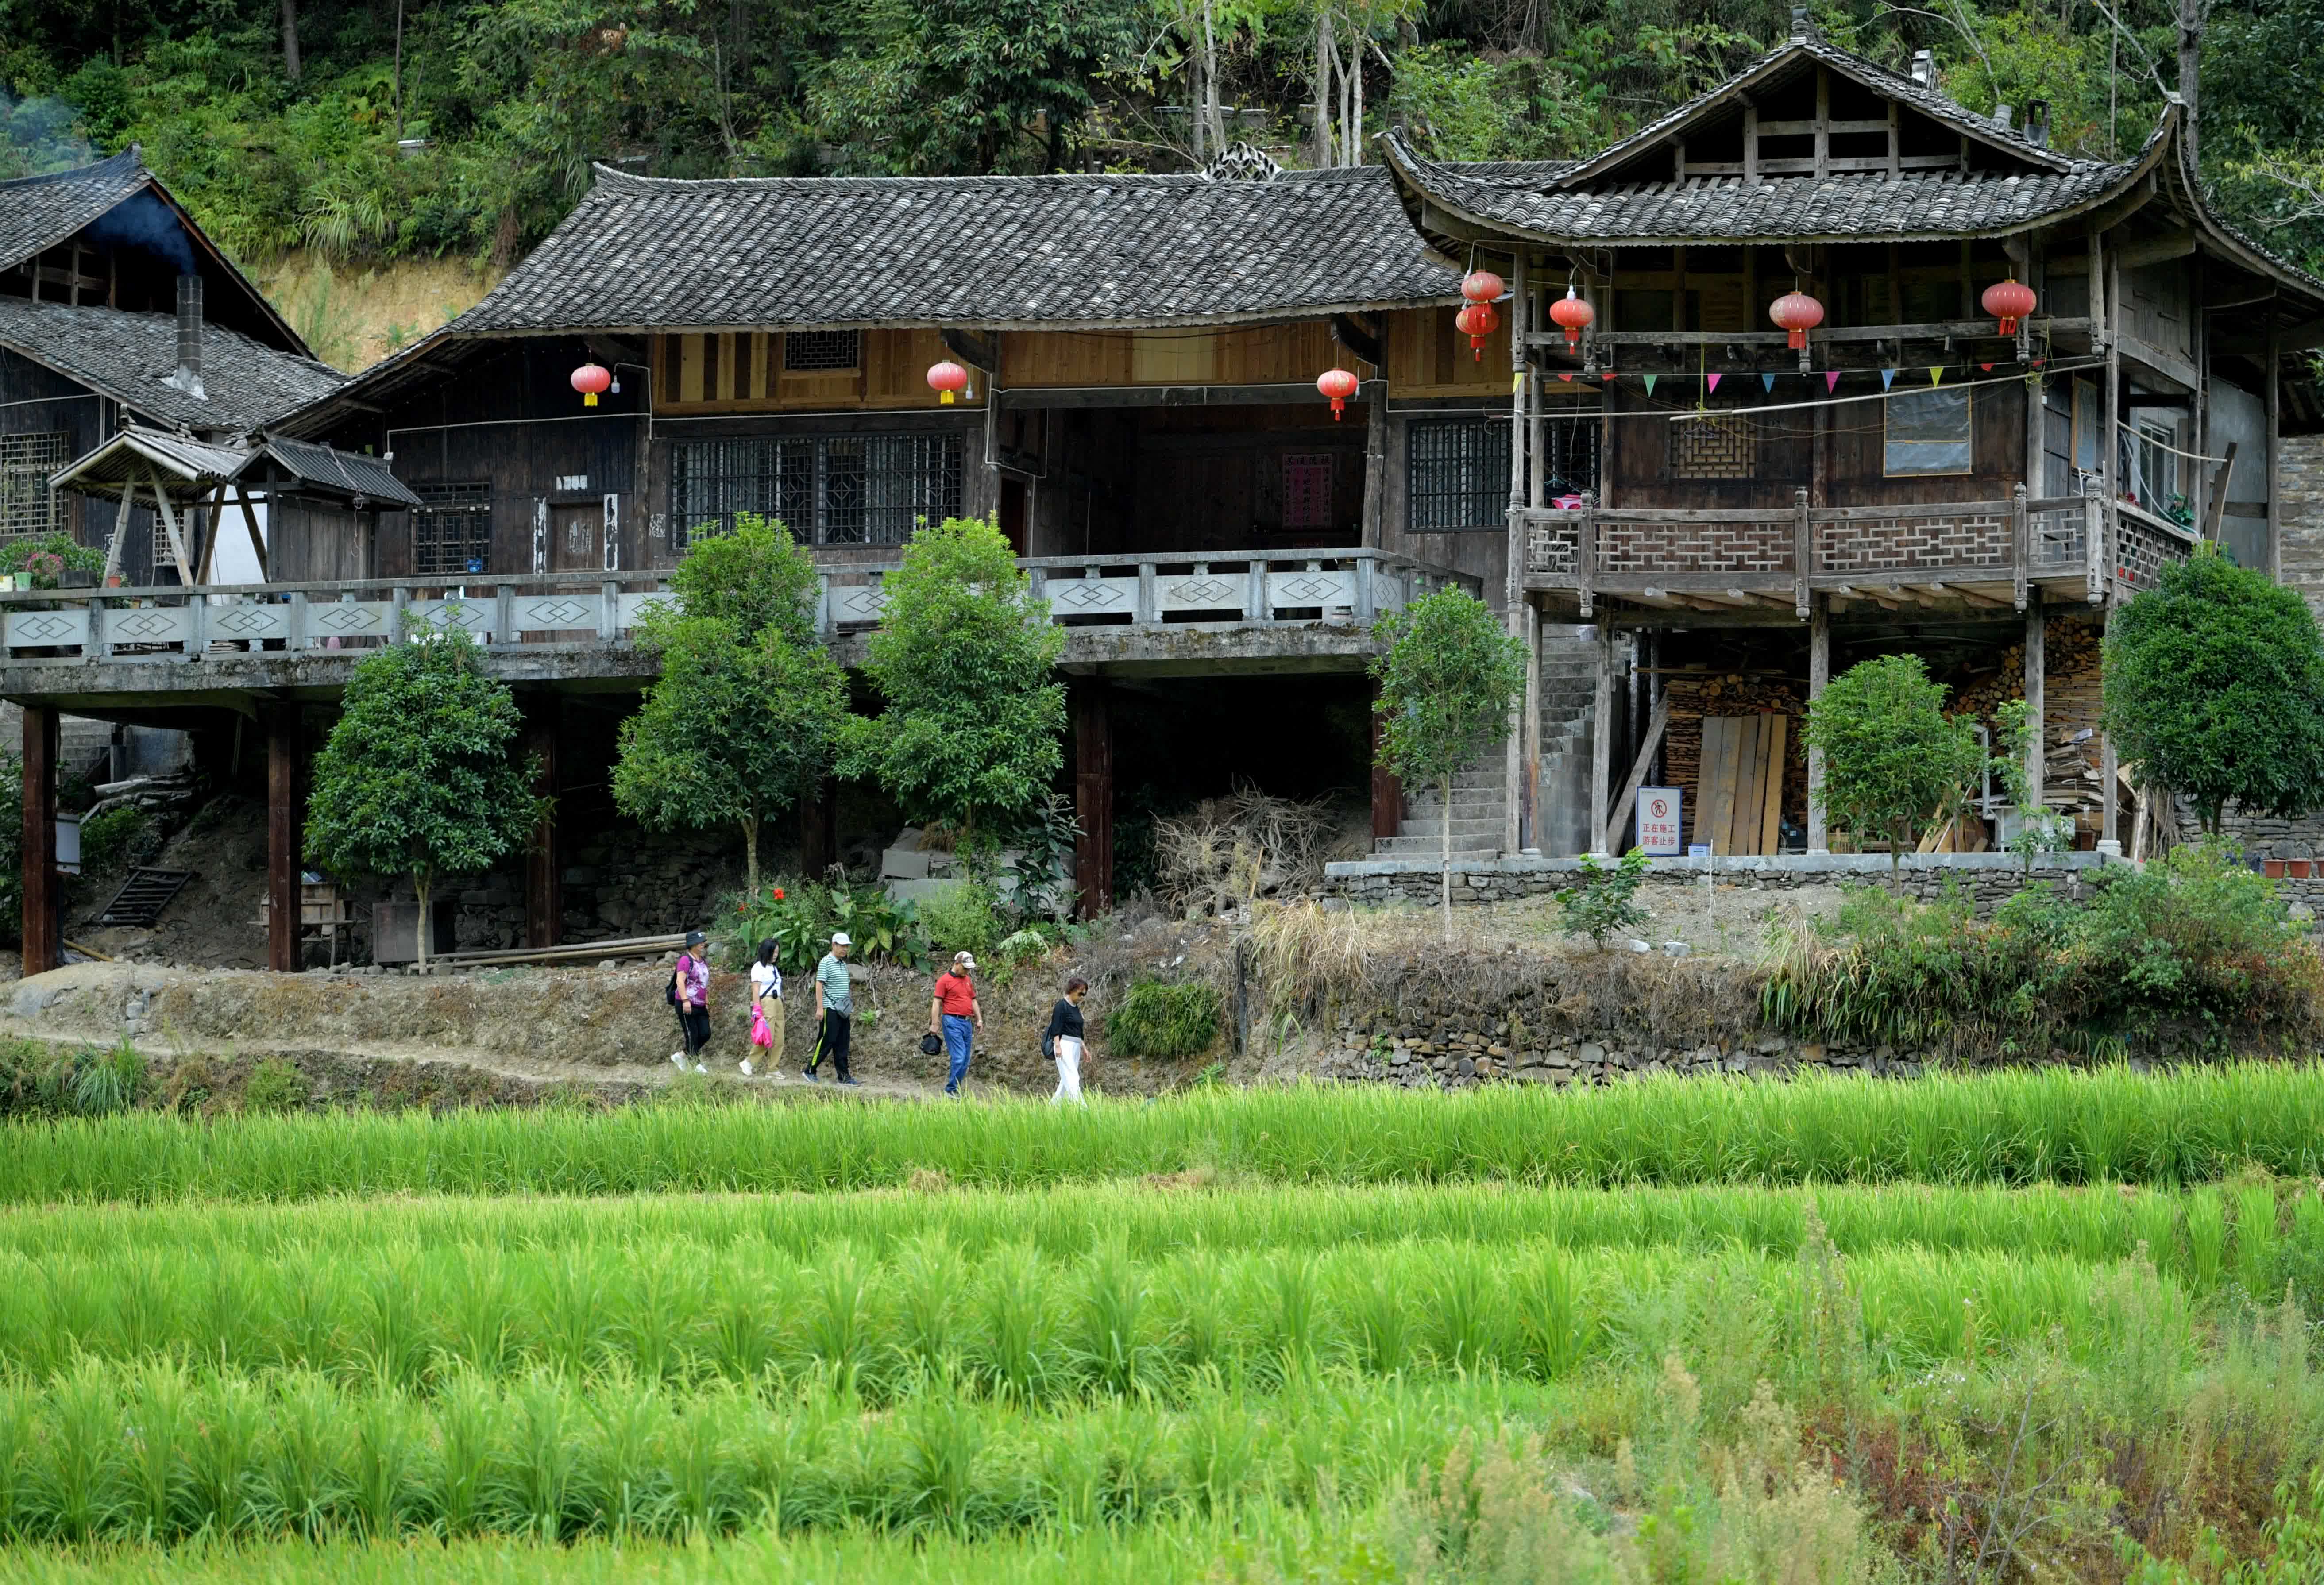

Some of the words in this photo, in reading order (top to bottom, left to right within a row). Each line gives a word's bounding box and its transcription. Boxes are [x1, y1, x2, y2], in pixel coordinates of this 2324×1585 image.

[1643, 823, 1675, 833] 正在施工
[1643, 835, 1675, 846] 游客止步
